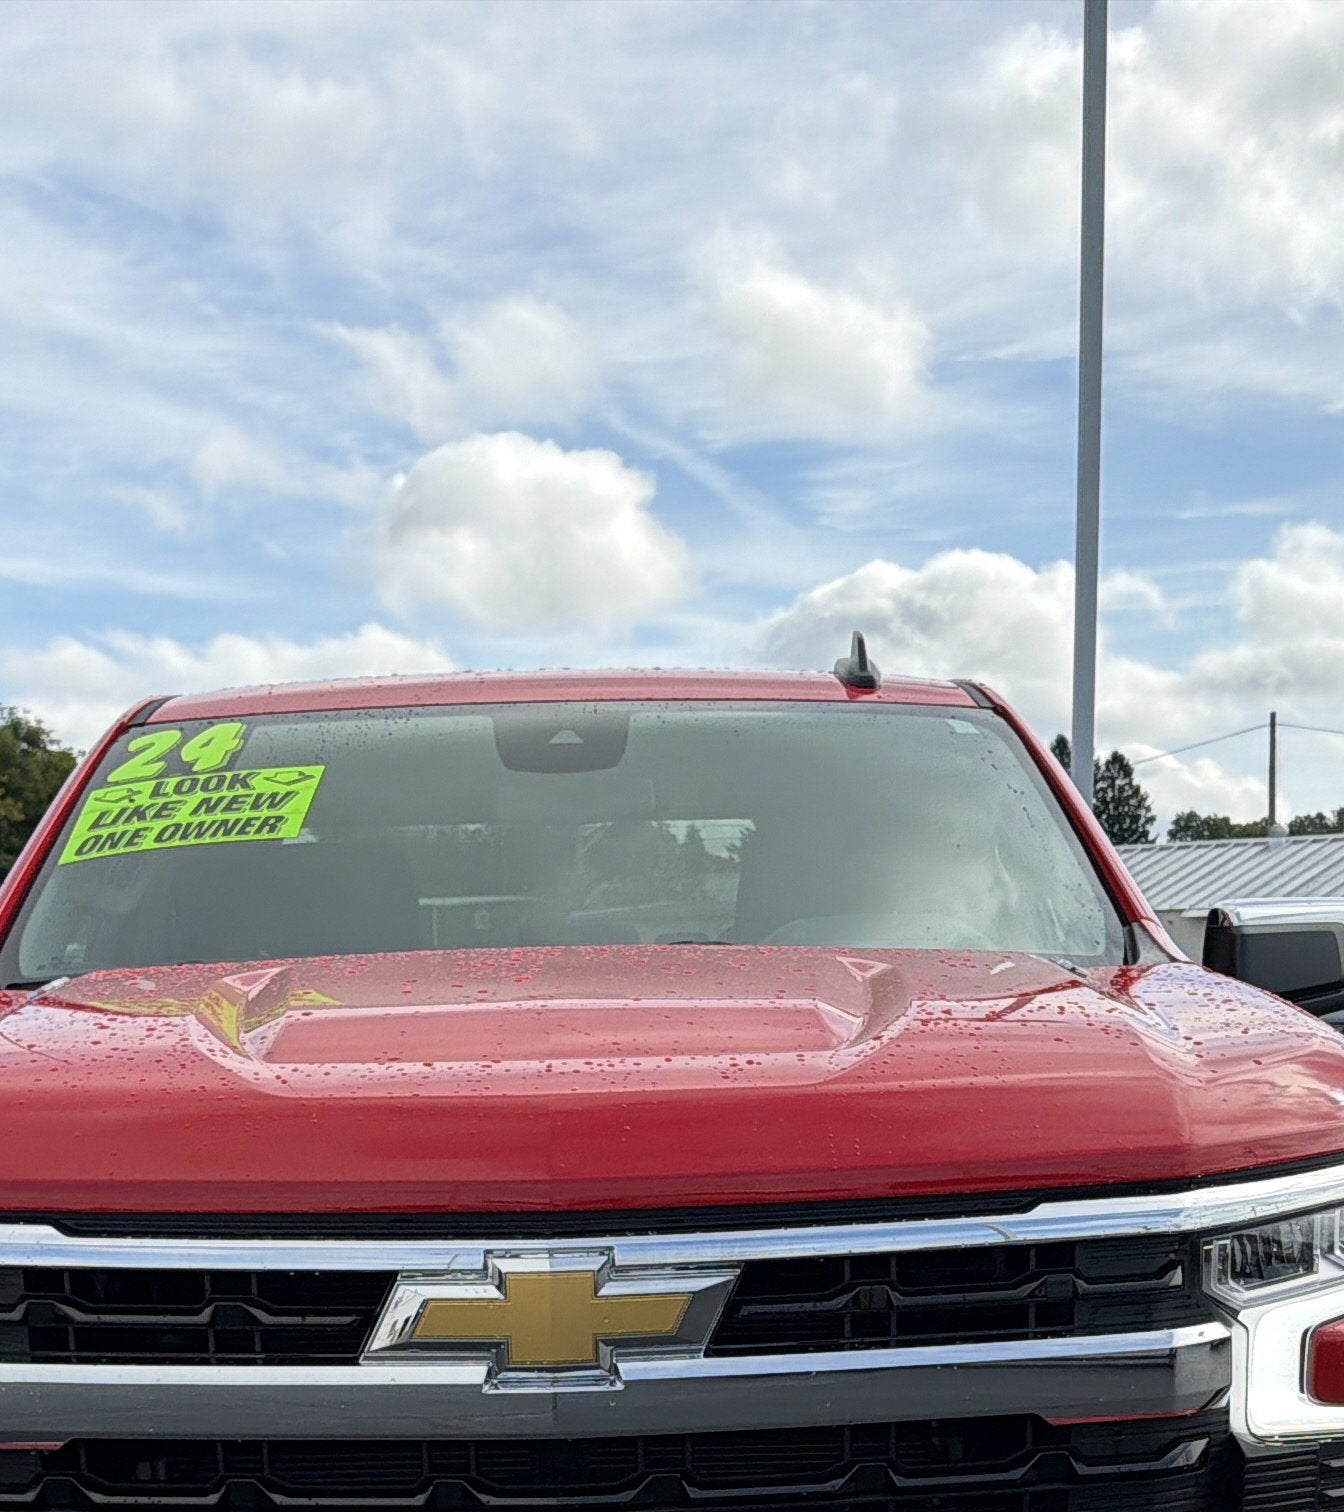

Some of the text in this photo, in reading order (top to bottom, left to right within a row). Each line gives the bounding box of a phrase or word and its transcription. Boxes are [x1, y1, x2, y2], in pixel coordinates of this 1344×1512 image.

[107, 722, 247, 783] 24
[148, 771, 257, 801] LOOK
[88, 790, 299, 831] LIKE NEW
[73, 815, 287, 857] ONE OWNER
